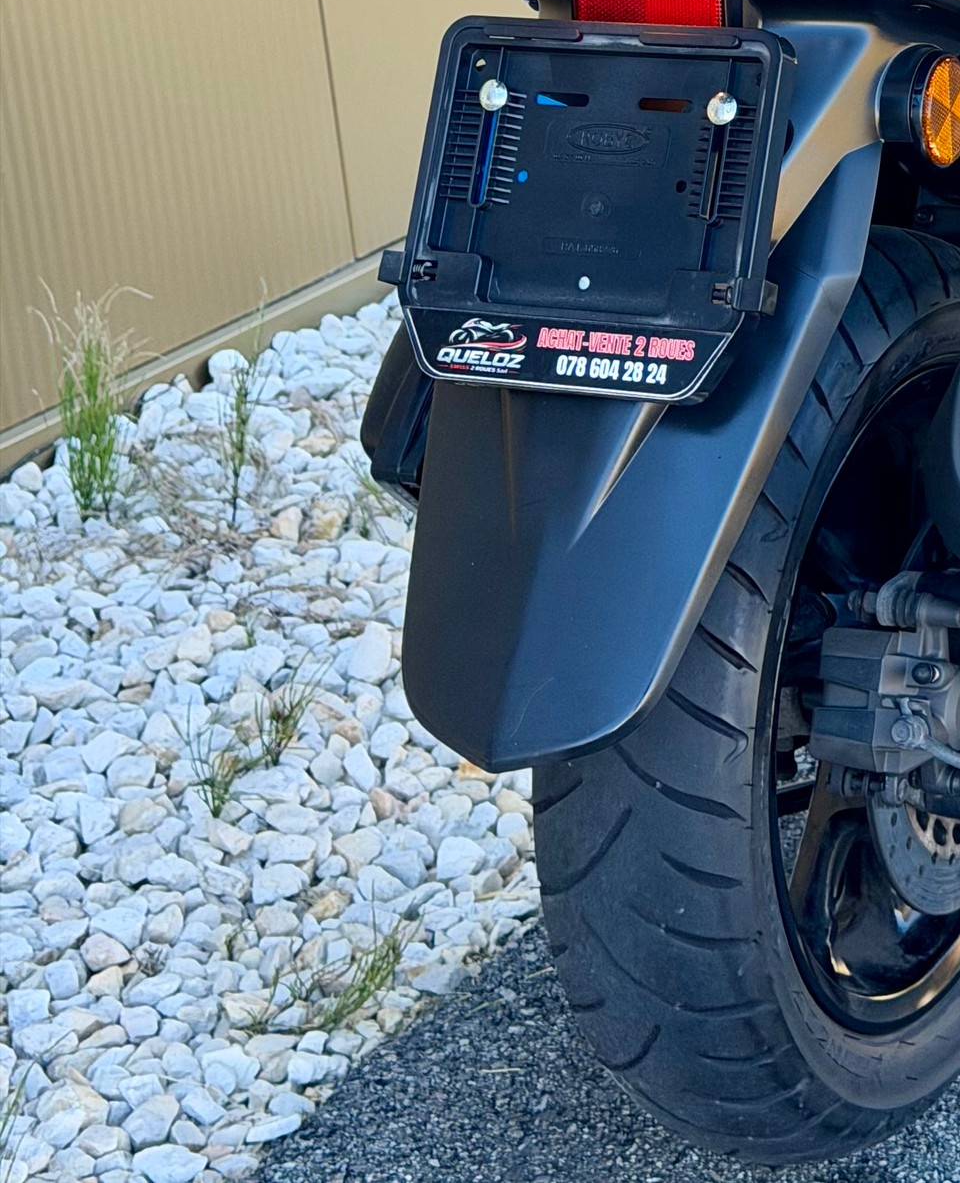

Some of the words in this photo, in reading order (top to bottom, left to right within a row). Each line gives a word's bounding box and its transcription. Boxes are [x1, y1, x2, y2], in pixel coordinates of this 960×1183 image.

[436, 347, 525, 368] QUELOZ
[537, 327, 632, 355] ACHAT-VENTE
[634, 336, 647, 356] 2
[648, 337, 695, 361] ROUES
[556, 355, 587, 377] 078
[589, 357, 620, 380] 604
[622, 360, 644, 382] 28
[646, 363, 668, 385] 24
